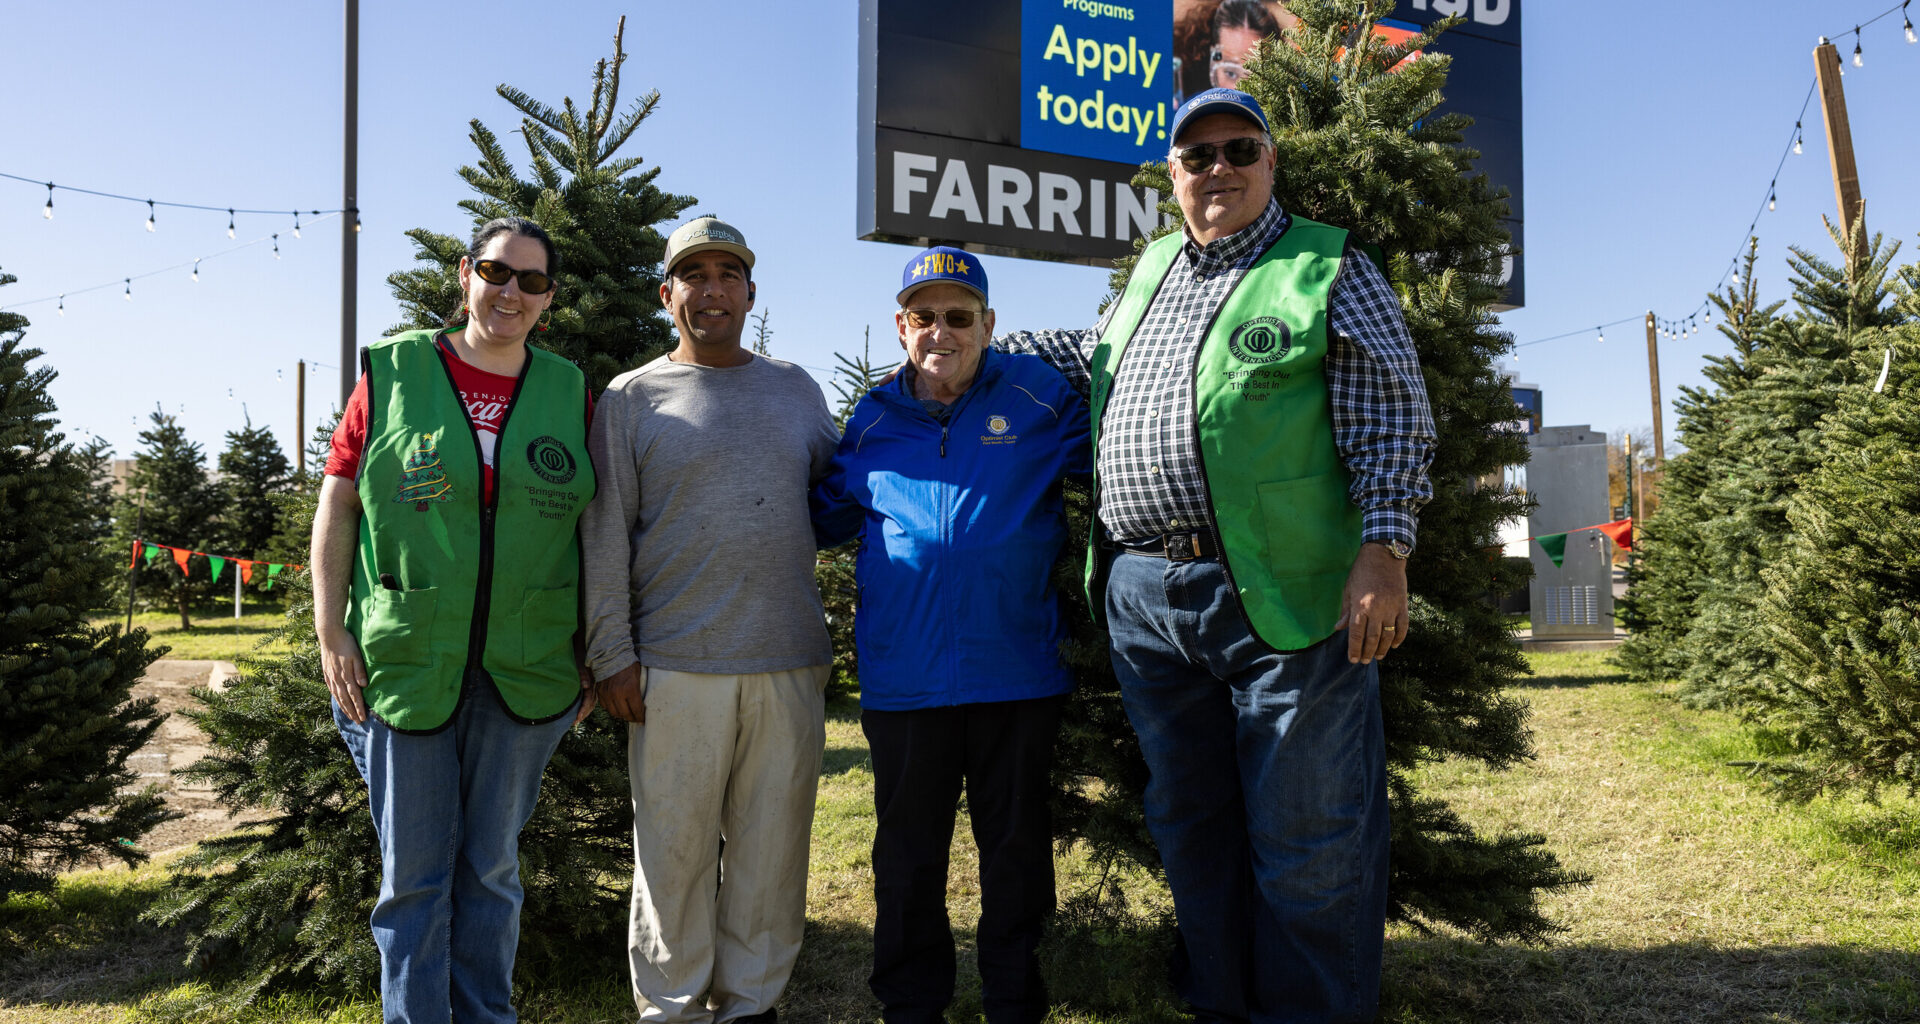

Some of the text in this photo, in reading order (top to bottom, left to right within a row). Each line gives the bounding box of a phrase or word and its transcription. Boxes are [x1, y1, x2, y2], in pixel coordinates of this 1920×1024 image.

[1043, 24, 1162, 88] Apply
[1037, 85, 1166, 146] today!
[893, 151, 1172, 242] FARRIN
[923, 253, 954, 276] FWO
[1242, 316, 1281, 329] OPTIMIST
[1230, 344, 1290, 364] INTERNATIONAL
[1222, 368, 1290, 380] "Bringing Out
[1230, 380, 1280, 391] The Best In
[473, 392, 511, 402] ENJO
[524, 485, 566, 500] "Bringing
[530, 498, 546, 507] The
[548, 500, 567, 511] Best
